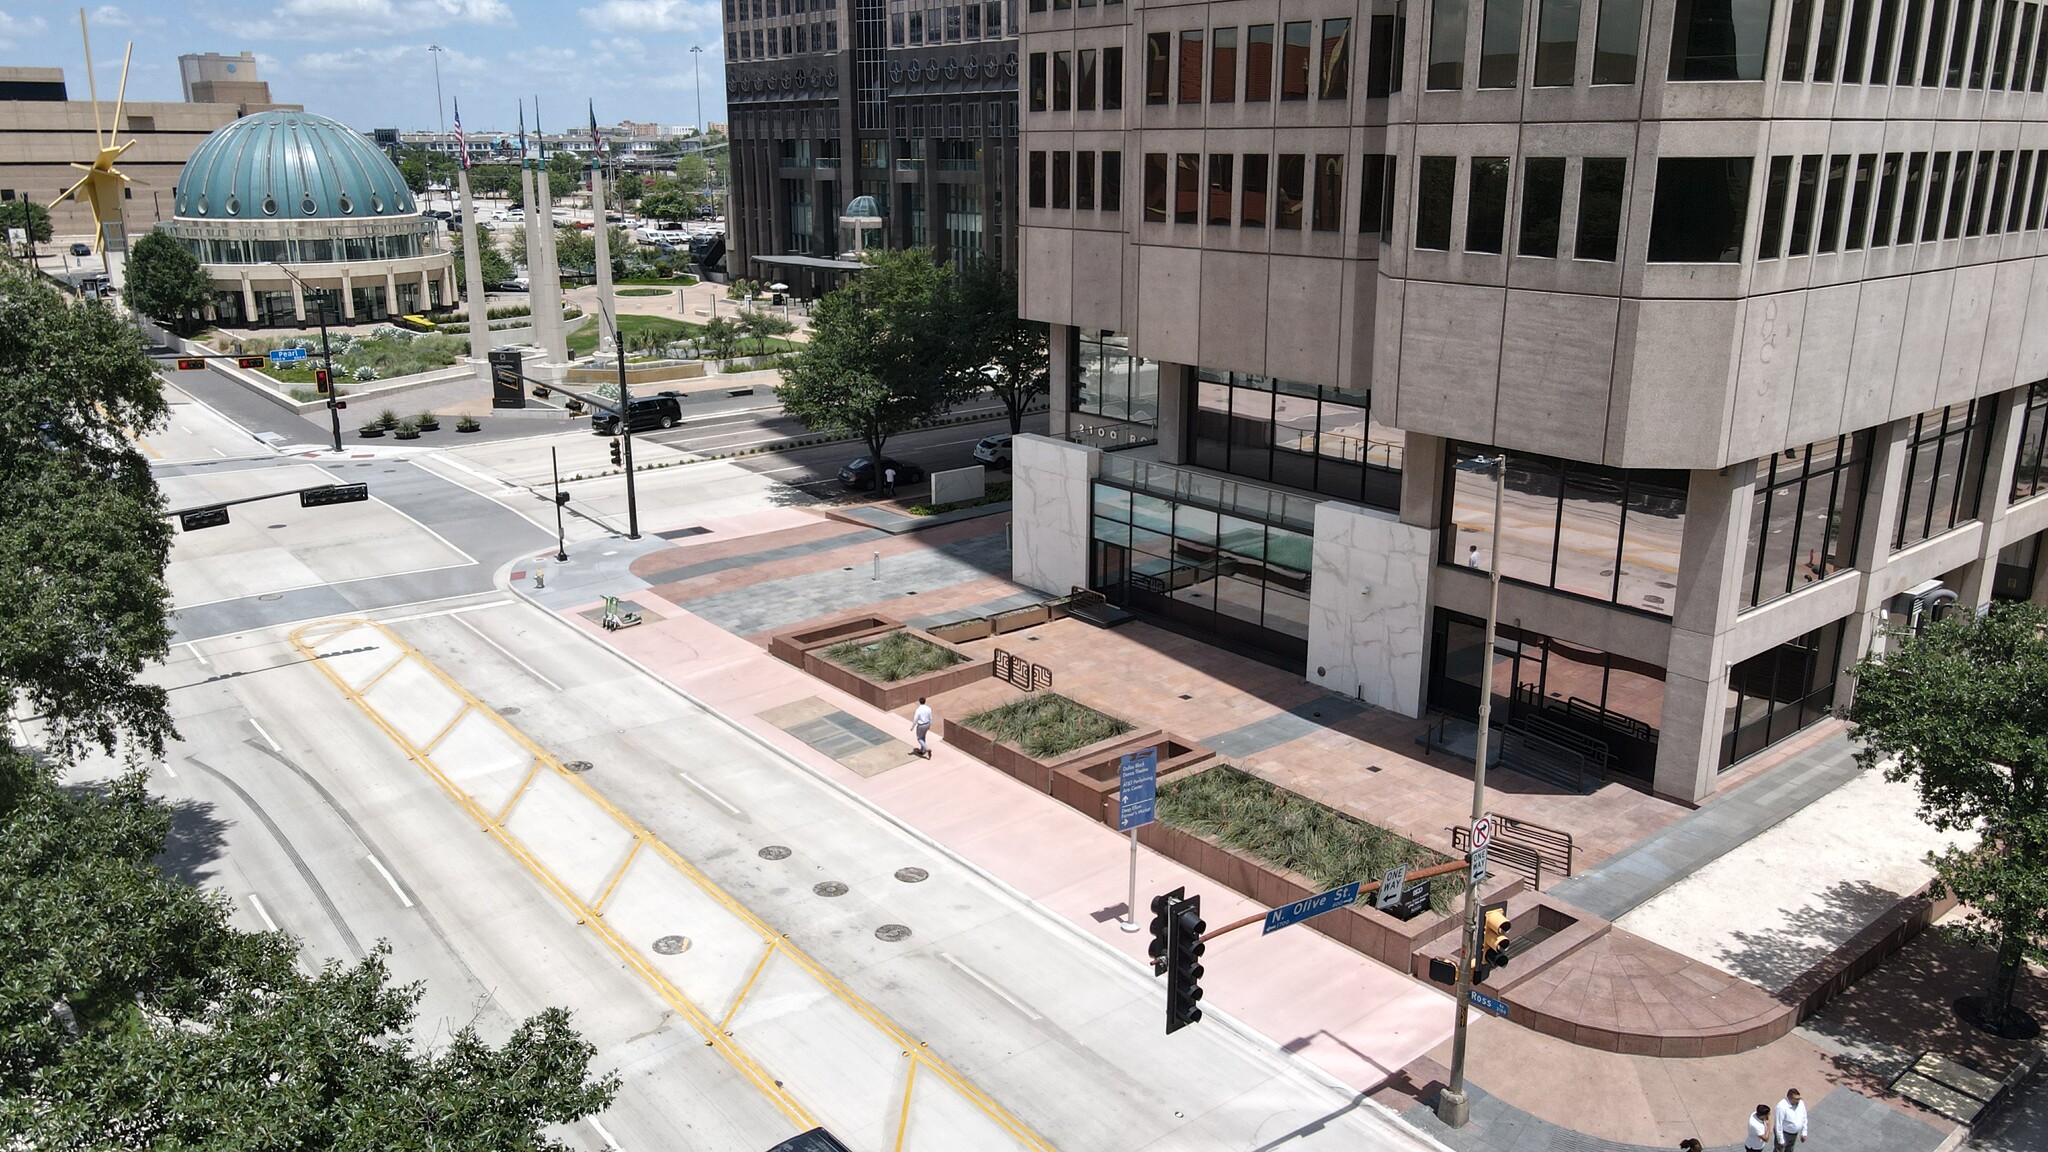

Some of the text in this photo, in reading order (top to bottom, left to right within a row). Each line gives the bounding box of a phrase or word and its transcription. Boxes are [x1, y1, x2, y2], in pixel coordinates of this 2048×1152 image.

[1079, 424, 1117, 439] 2100
[1122, 764, 1134, 772] Dallas
[1133, 776, 1153, 784] Performing
[1473, 850, 1486, 862] ONE
[1473, 858, 1485, 870] WAY
[1386, 868, 1403, 882] ONE
[1383, 879, 1402, 892] WAY
[1271, 887, 1351, 924] N. Olive St.
[1471, 991, 1492, 1007] Ross
